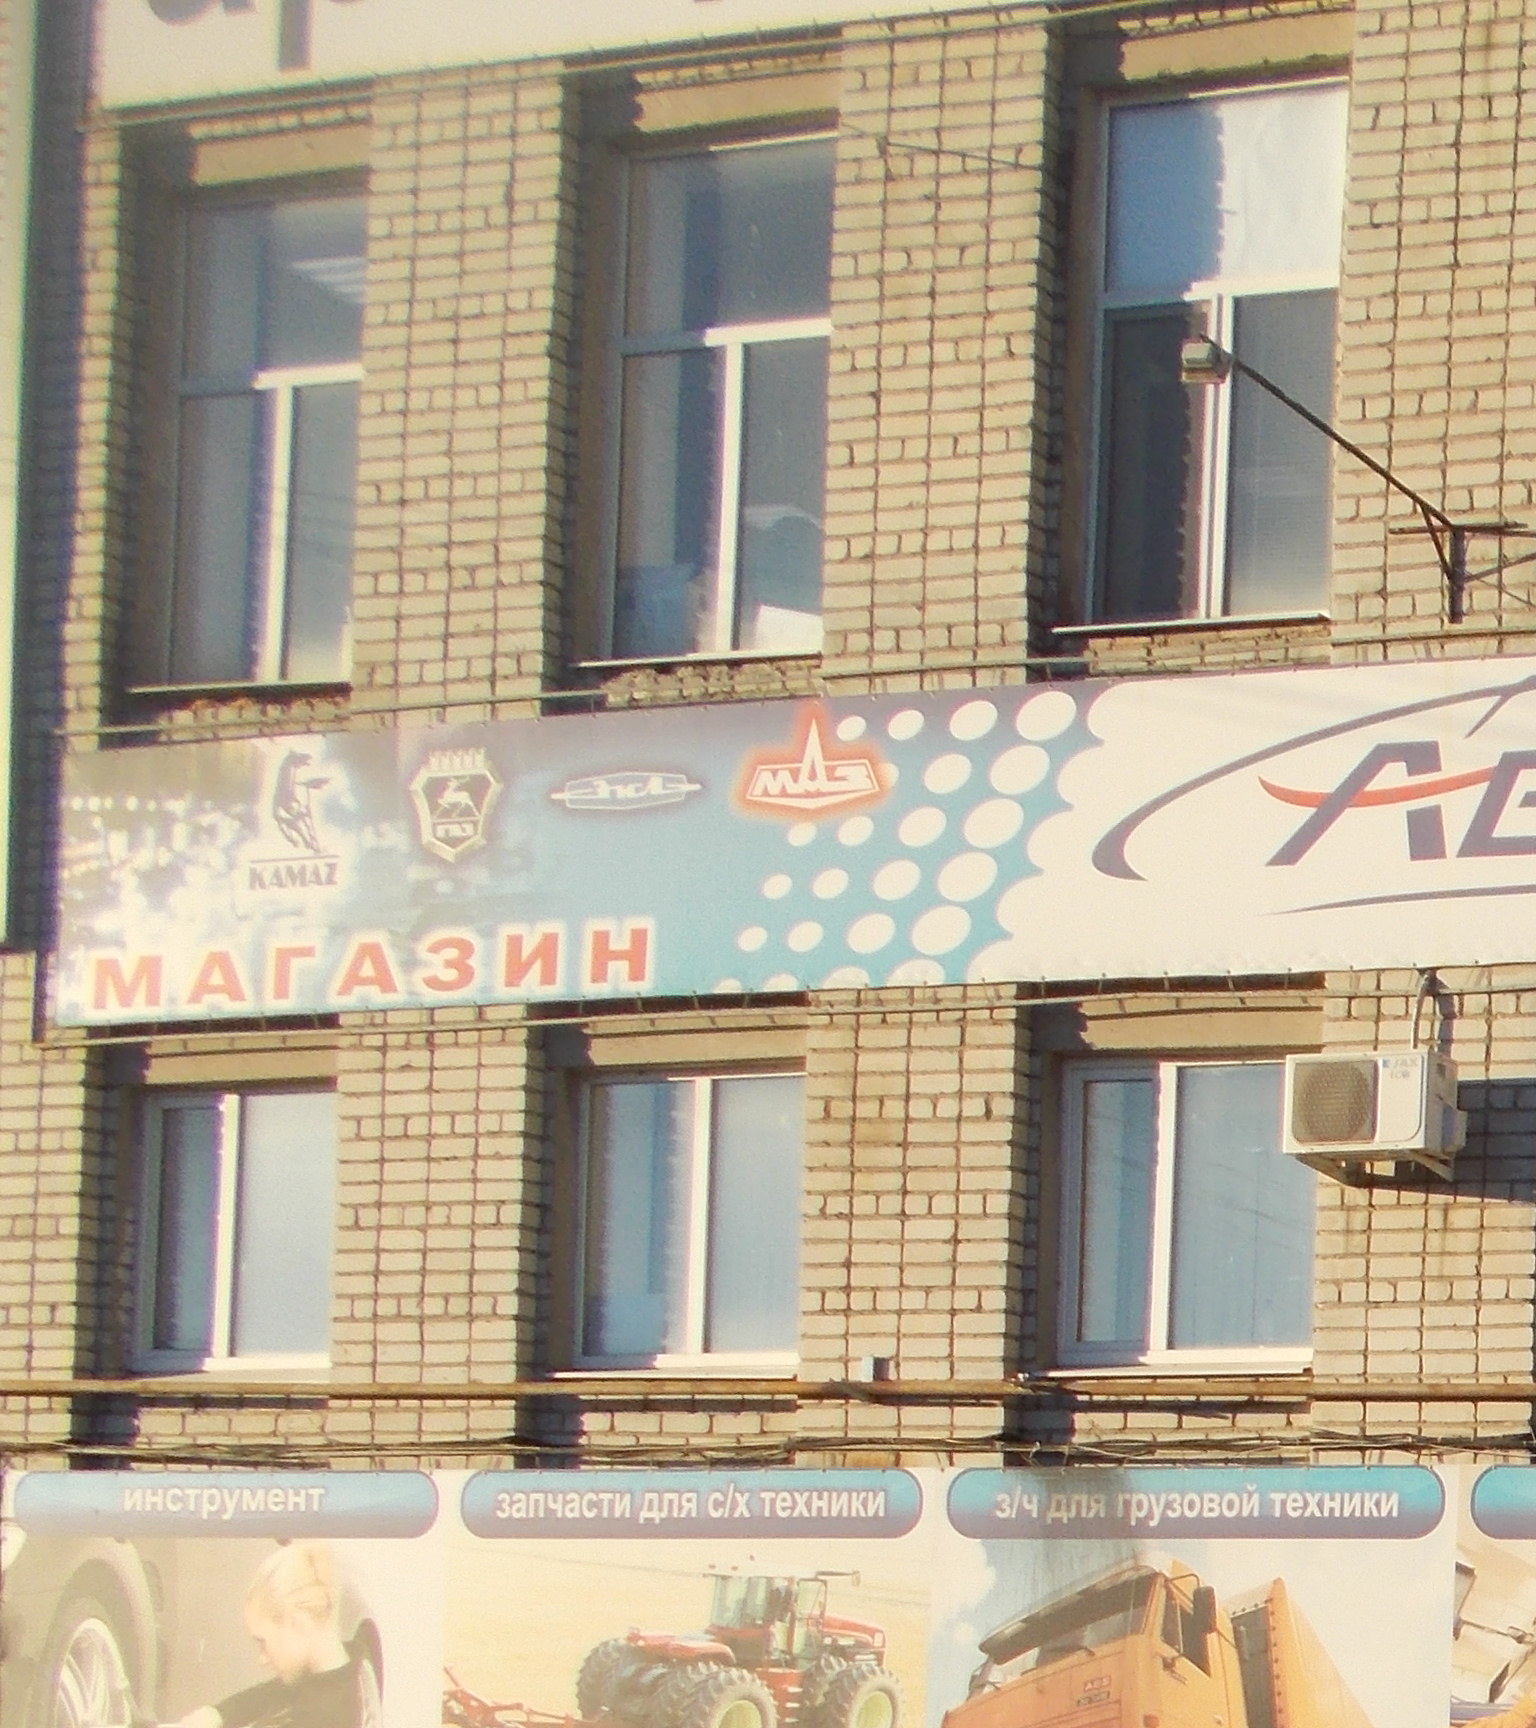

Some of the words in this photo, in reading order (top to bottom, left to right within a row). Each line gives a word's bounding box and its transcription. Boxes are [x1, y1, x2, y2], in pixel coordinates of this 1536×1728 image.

[250, 862, 339, 890] KAMAZ
[92, 927, 650, 1011] МАГАЗИН
[123, 1485, 324, 1520] инструмент
[496, 1489, 631, 1520] запчасти
[638, 1490, 697, 1523] для
[707, 1486, 752, 1520] с/х
[761, 1488, 886, 1519] техники
[996, 1487, 1039, 1520] з/ч
[1047, 1489, 1104, 1523] для
[1117, 1483, 1261, 1525] грузовой
[1271, 1489, 1400, 1520] техники
